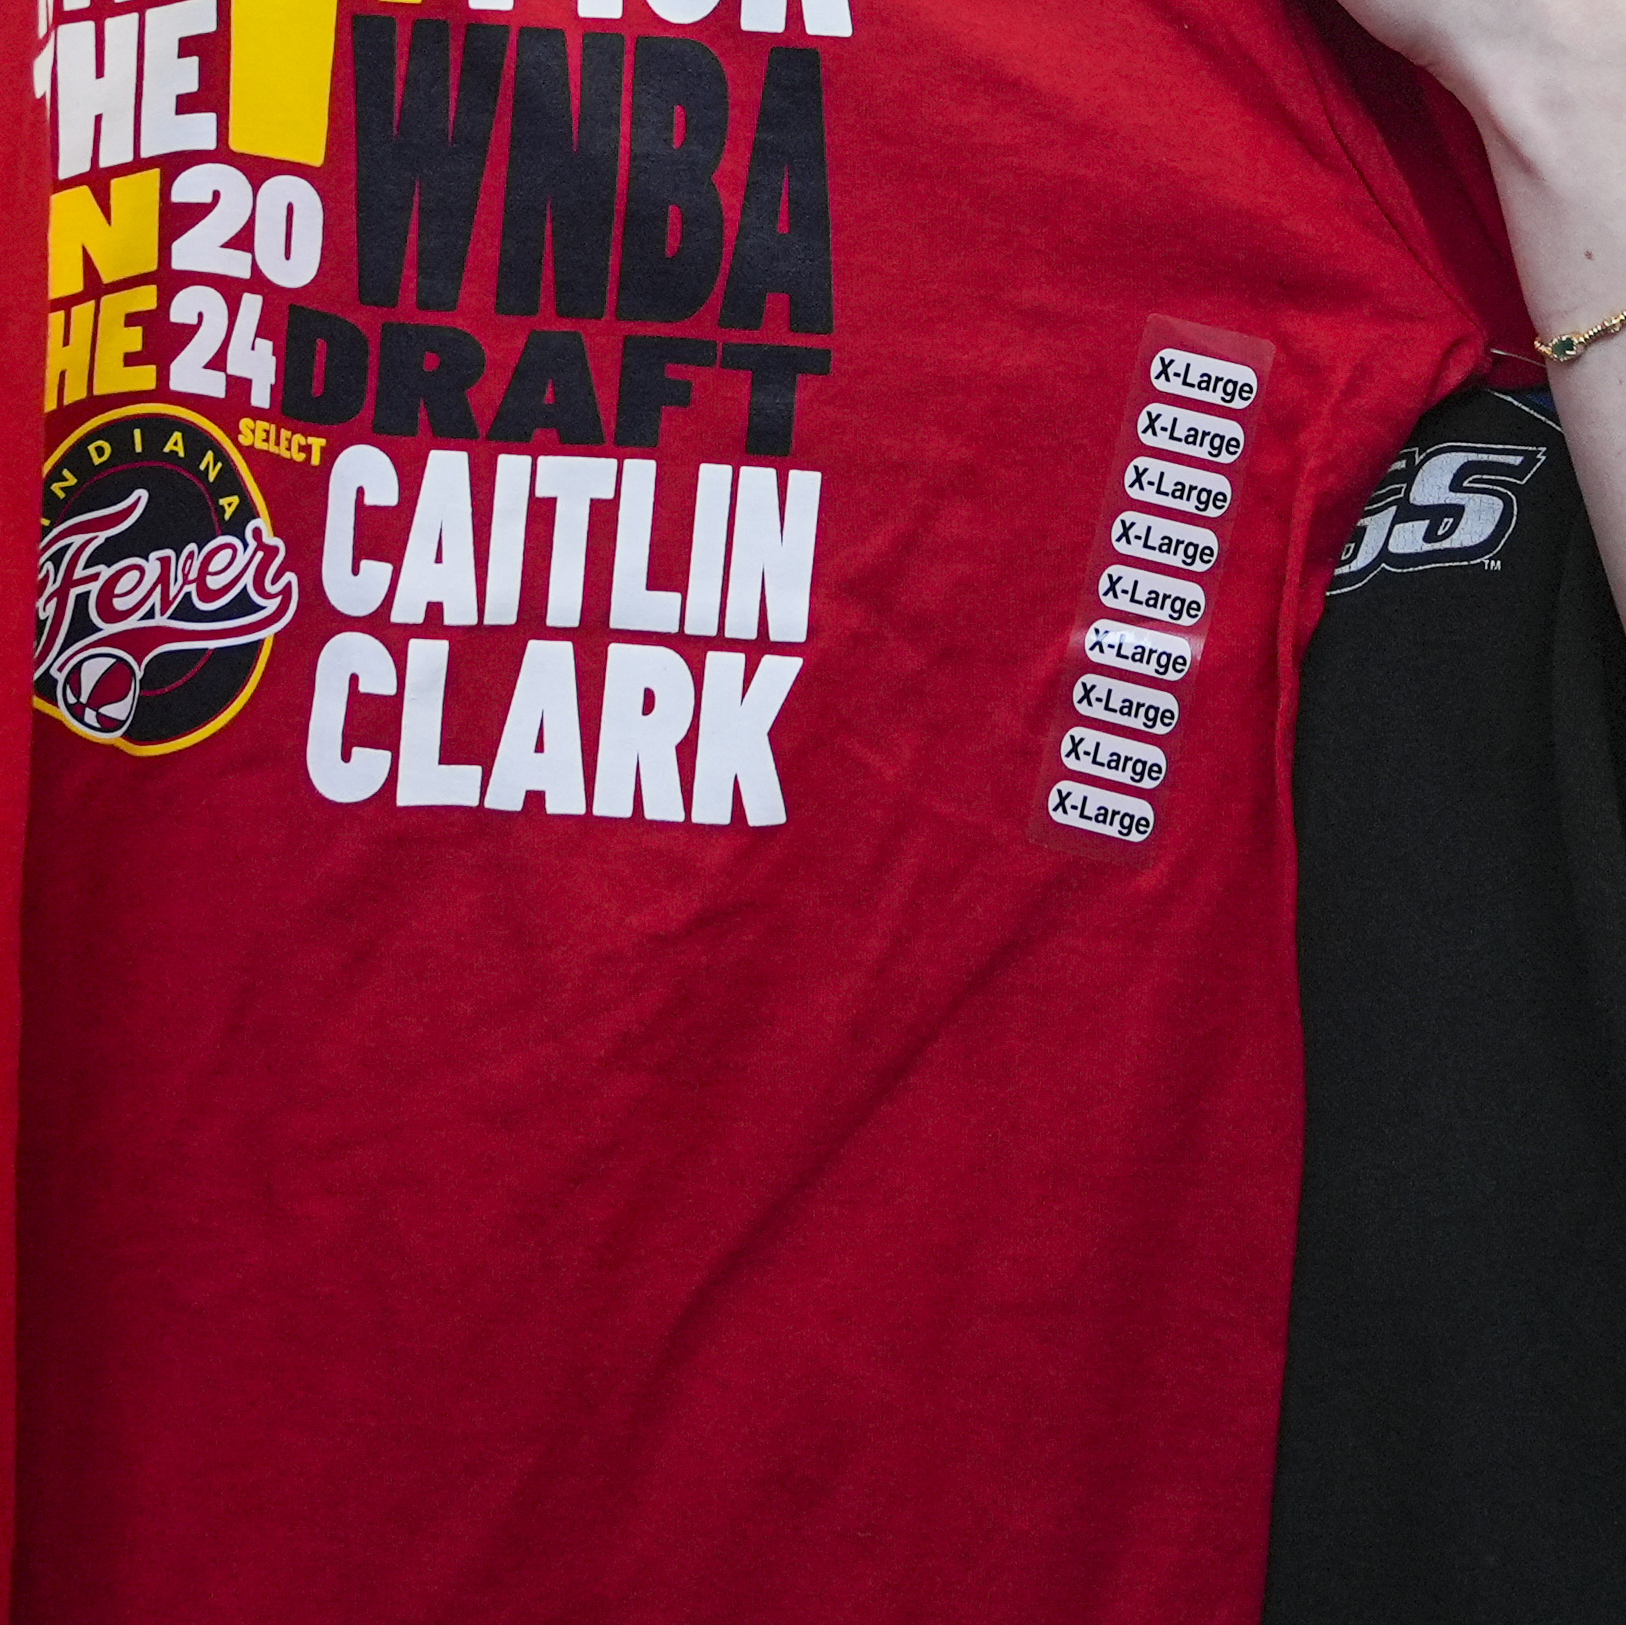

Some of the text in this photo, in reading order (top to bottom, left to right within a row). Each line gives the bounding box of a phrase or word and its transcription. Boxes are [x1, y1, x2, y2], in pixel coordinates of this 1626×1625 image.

[352, 14, 834, 335] WNBA
[170, 163, 324, 288] 20
[43, 284, 158, 413] HE
[169, 285, 276, 409] 24
[281, 303, 832, 455] DRAFT
[1154, 356, 1253, 403] X-Large
[238, 418, 326, 466] SELECT
[1141, 411, 1241, 458] X-Large
[1128, 465, 1228, 512] X-Large
[322, 445, 822, 643] CAITLIN
[1115, 519, 1215, 566] X-Large
[33, 489, 299, 682] Fever
[1102, 573, 1202, 620] X-Large
[1089, 628, 1188, 675] X-Large
[306, 632, 804, 827] CLARK
[1077, 682, 1176, 729] X-Large
[1065, 734, 1163, 783] X-Large
[1052, 788, 1150, 836] X-Large
